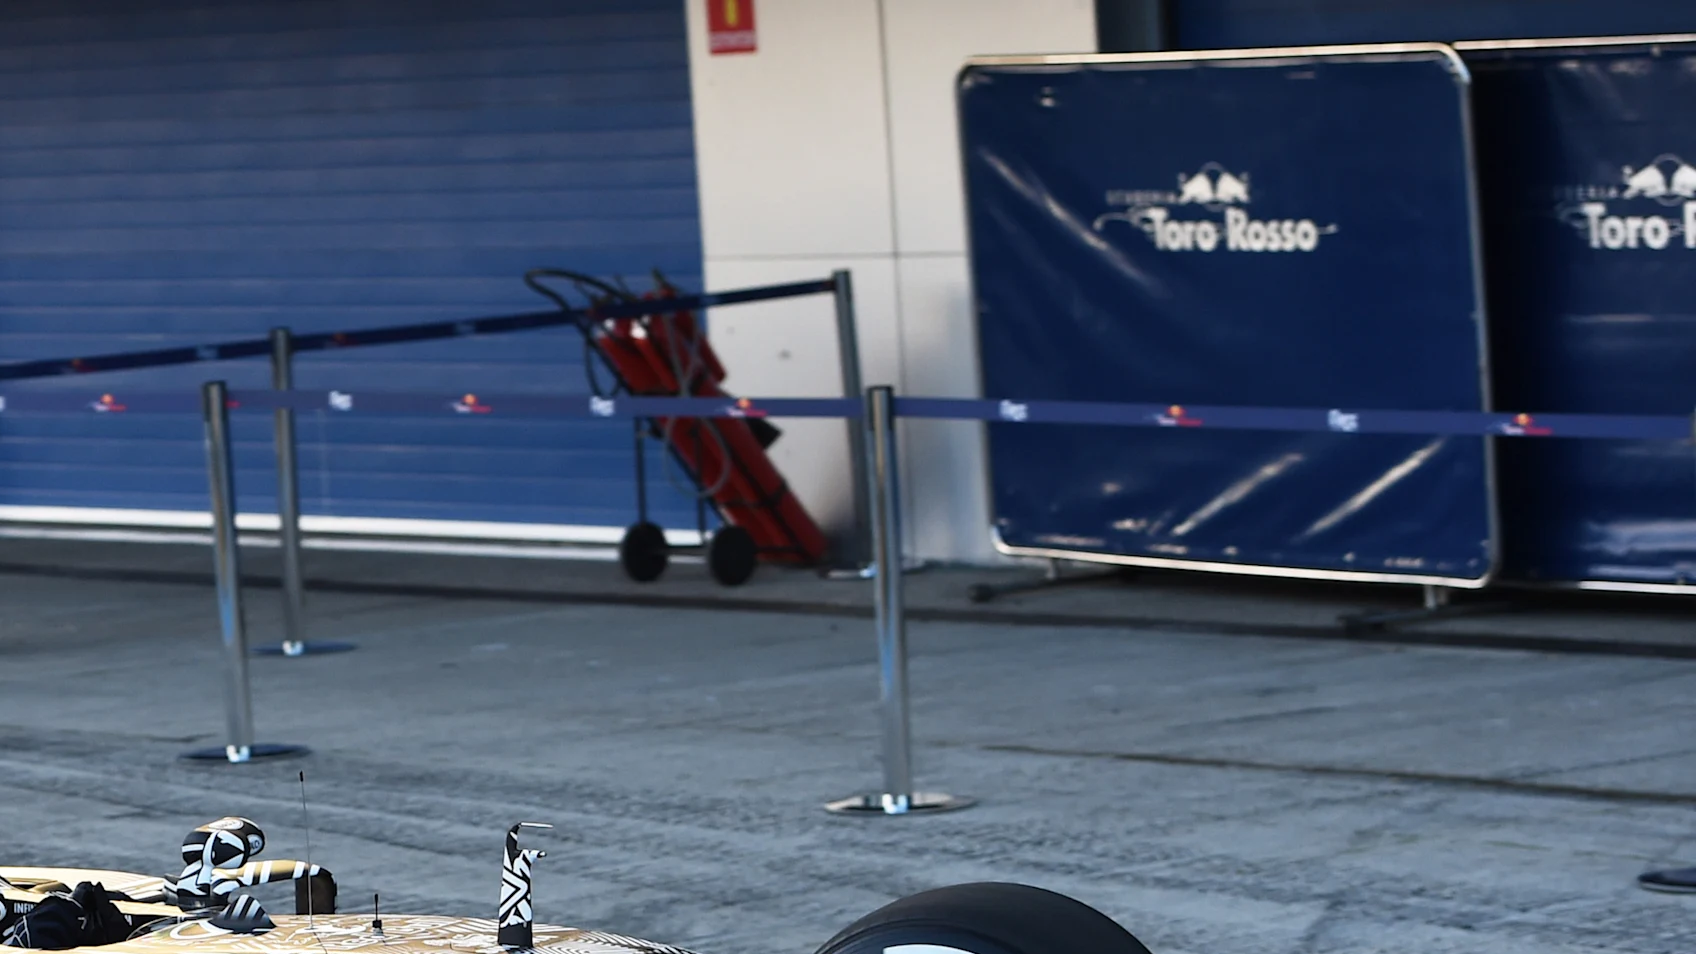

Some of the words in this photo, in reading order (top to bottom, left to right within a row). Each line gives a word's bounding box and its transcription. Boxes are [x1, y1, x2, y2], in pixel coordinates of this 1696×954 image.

[1147, 205, 1218, 251] Toro
[1224, 205, 1320, 252] Rosso
[1582, 202, 1670, 250] Toro
